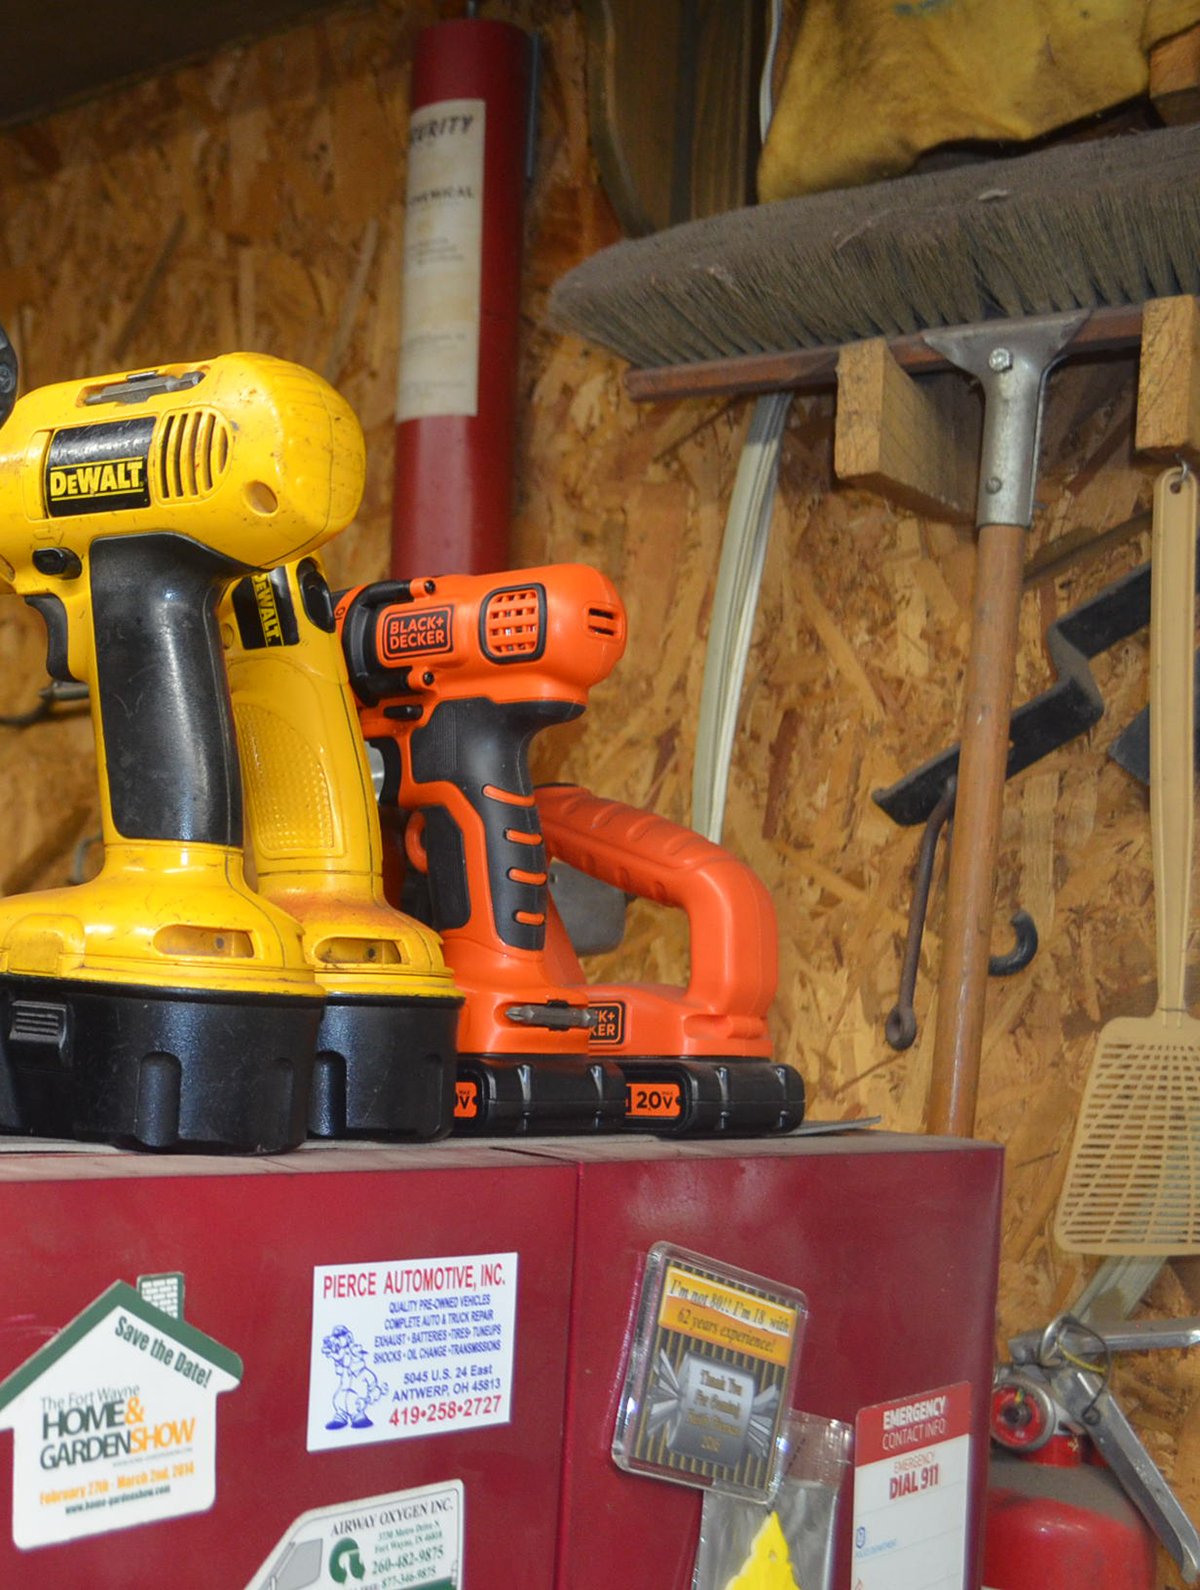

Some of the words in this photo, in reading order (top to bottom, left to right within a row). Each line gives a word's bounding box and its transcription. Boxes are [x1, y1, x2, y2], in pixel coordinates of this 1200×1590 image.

[50, 461, 143, 497] DEWALT
[389, 629, 445, 650] DECKER
[636, 1090, 673, 1110] 20V
[323, 1271, 377, 1299] PIERCE
[383, 1265, 478, 1295] AUTOMOTIVE,
[480, 1262, 506, 1287] INC.
[389, 1300, 418, 1314] QUALITY
[419, 1296, 458, 1312] PRE-OWNED
[460, 1294, 491, 1308] VEHICLES
[384, 1315, 421, 1331] COMPLETE
[422, 1313, 440, 1328] AUTO
[448, 1311, 470, 1325] TRUCK
[471, 1309, 494, 1323] REPAIR
[114, 1315, 149, 1352] Save
[149, 1336, 174, 1367] the
[174, 1351, 212, 1389] Date!
[374, 1332, 406, 1348] EXHAUST
[373, 1349, 402, 1365] SHOCKS
[419, 1345, 447, 1360] CHANGE
[403, 1369, 428, 1385] 5045
[431, 1367, 451, 1382] U.S.
[455, 1365, 467, 1378] 24
[470, 1364, 492, 1377] East
[40, 1395, 66, 1413] The
[68, 1390, 95, 1407] Fort
[97, 1384, 141, 1403] Wayne
[392, 1385, 449, 1402] ANTWERP,
[453, 1381, 469, 1394] OH
[471, 1377, 501, 1392] 45813
[882, 1395, 948, 1431] EMERGENCY
[882, 1425, 923, 1451] CONTACT
[924, 1417, 947, 1439] INFO
[888, 1470, 919, 1501] DIAL
[920, 1463, 940, 1490] 911
[330, 1514, 377, 1536] AIRWAY
[379, 1501, 428, 1525] OXYGEN
